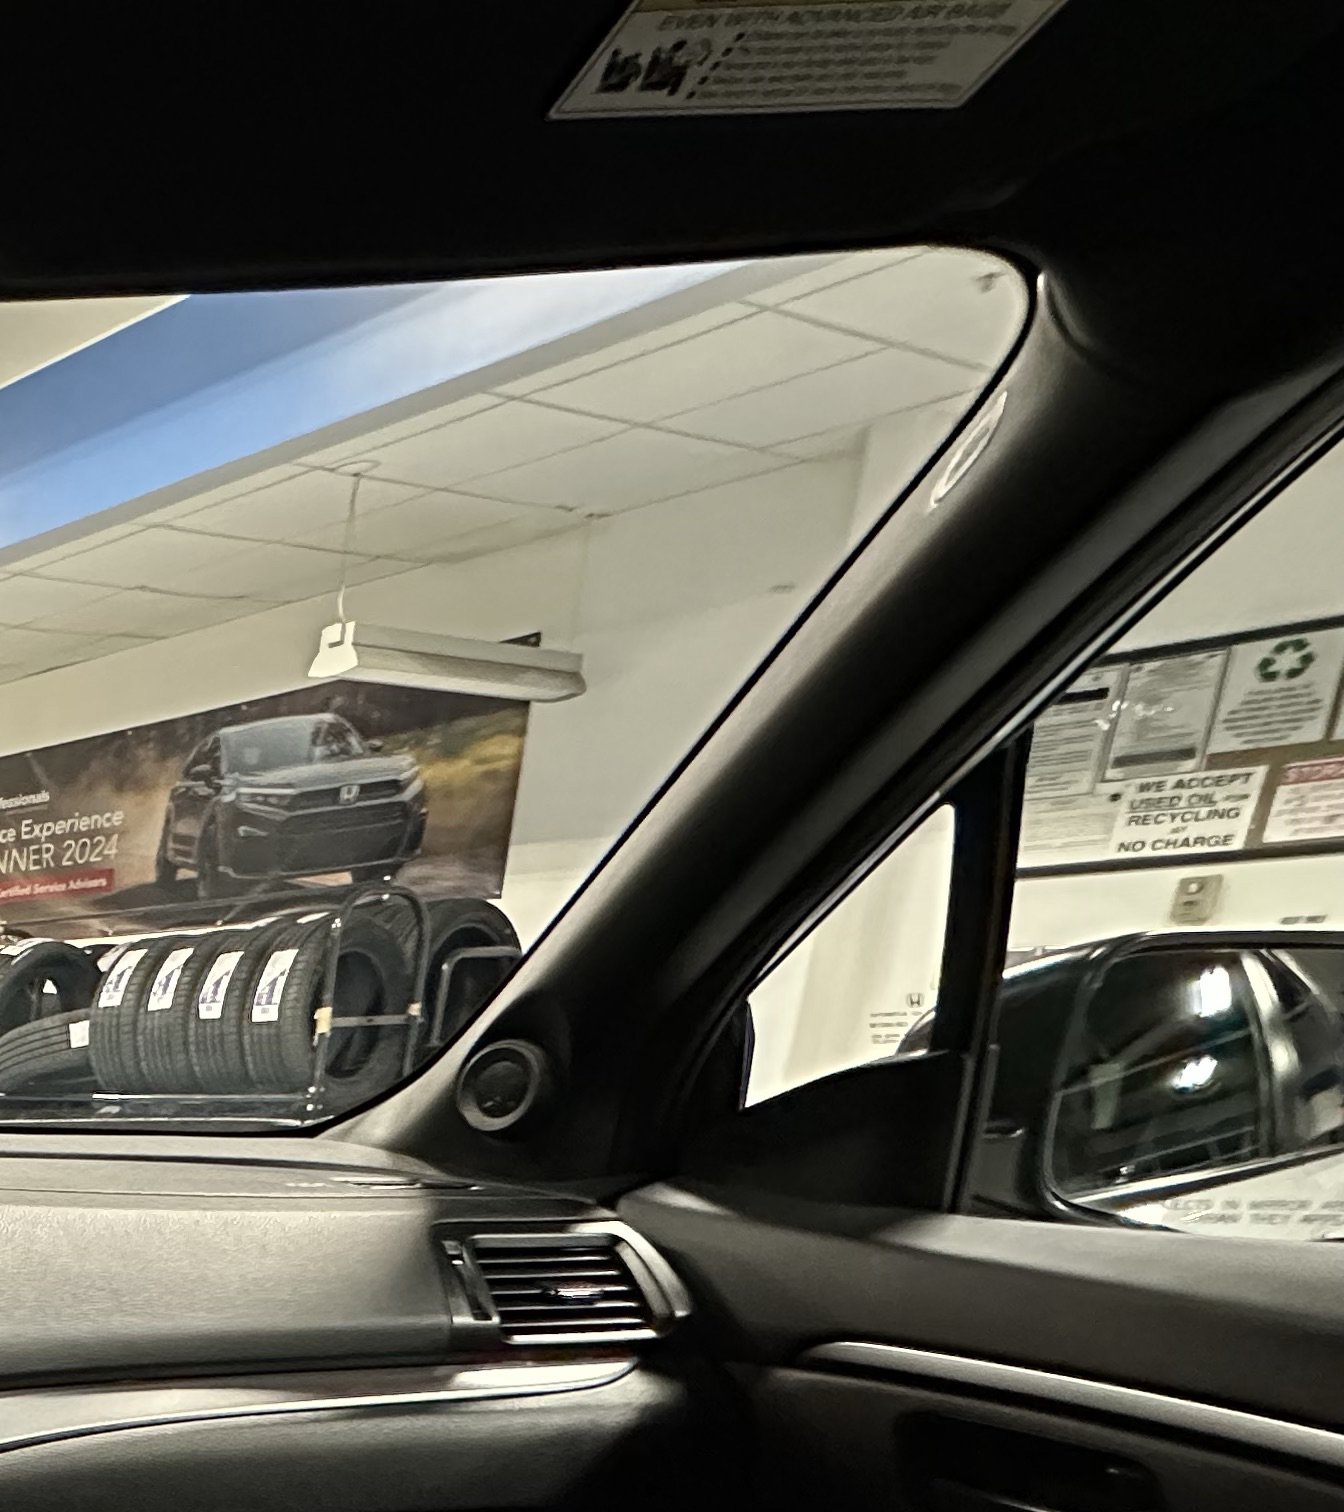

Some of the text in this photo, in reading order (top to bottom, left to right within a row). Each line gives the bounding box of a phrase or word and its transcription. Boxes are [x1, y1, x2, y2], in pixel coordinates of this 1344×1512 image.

[1172, 772, 1255, 789] ACCEPT
[1129, 796, 1181, 811] USED
[1187, 792, 1217, 806] OIL
[20, 809, 124, 842] Experience
[1127, 807, 1241, 826] RECYCLING
[61, 833, 119, 867] 2024
[1116, 834, 1236, 853] NO CHARGE
